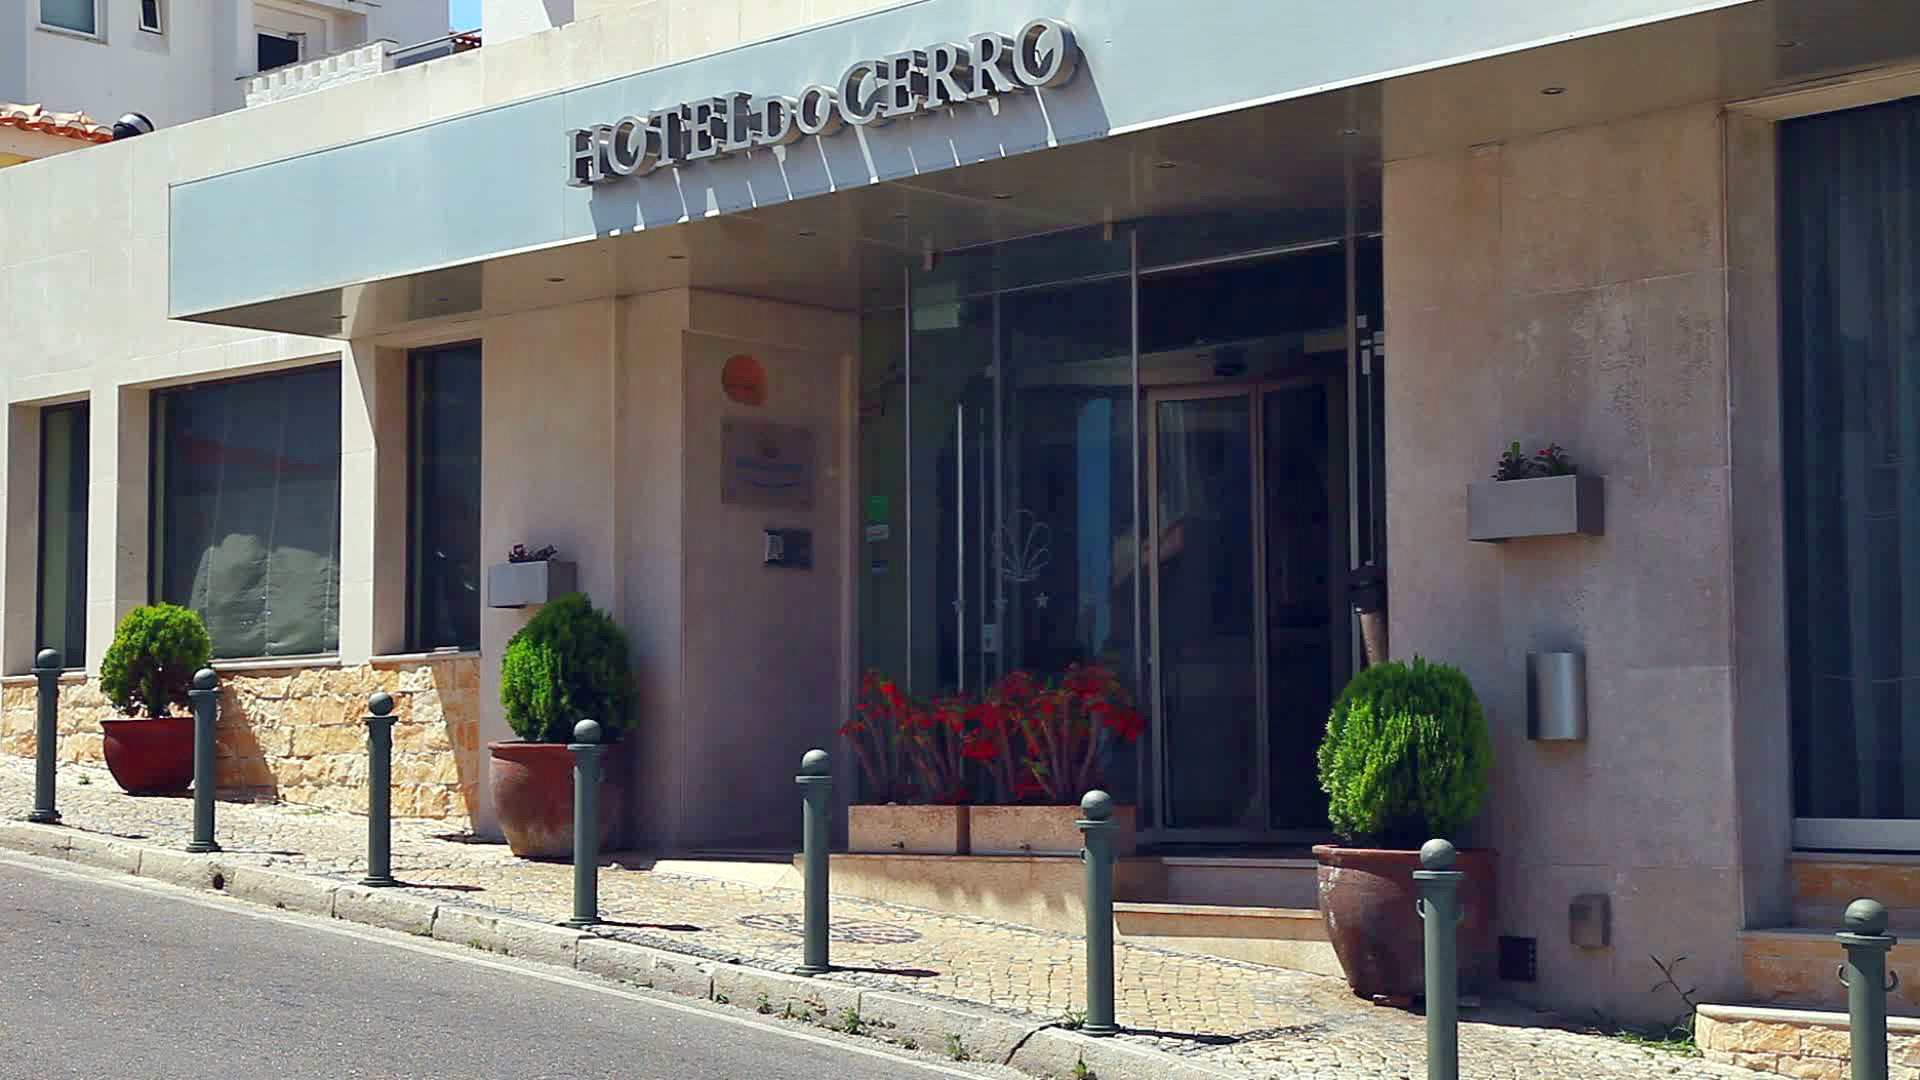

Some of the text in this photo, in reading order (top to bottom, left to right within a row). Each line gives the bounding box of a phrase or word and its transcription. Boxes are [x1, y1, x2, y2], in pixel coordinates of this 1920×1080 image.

[565, 17, 1075, 187] HOTEL DO CERRO
